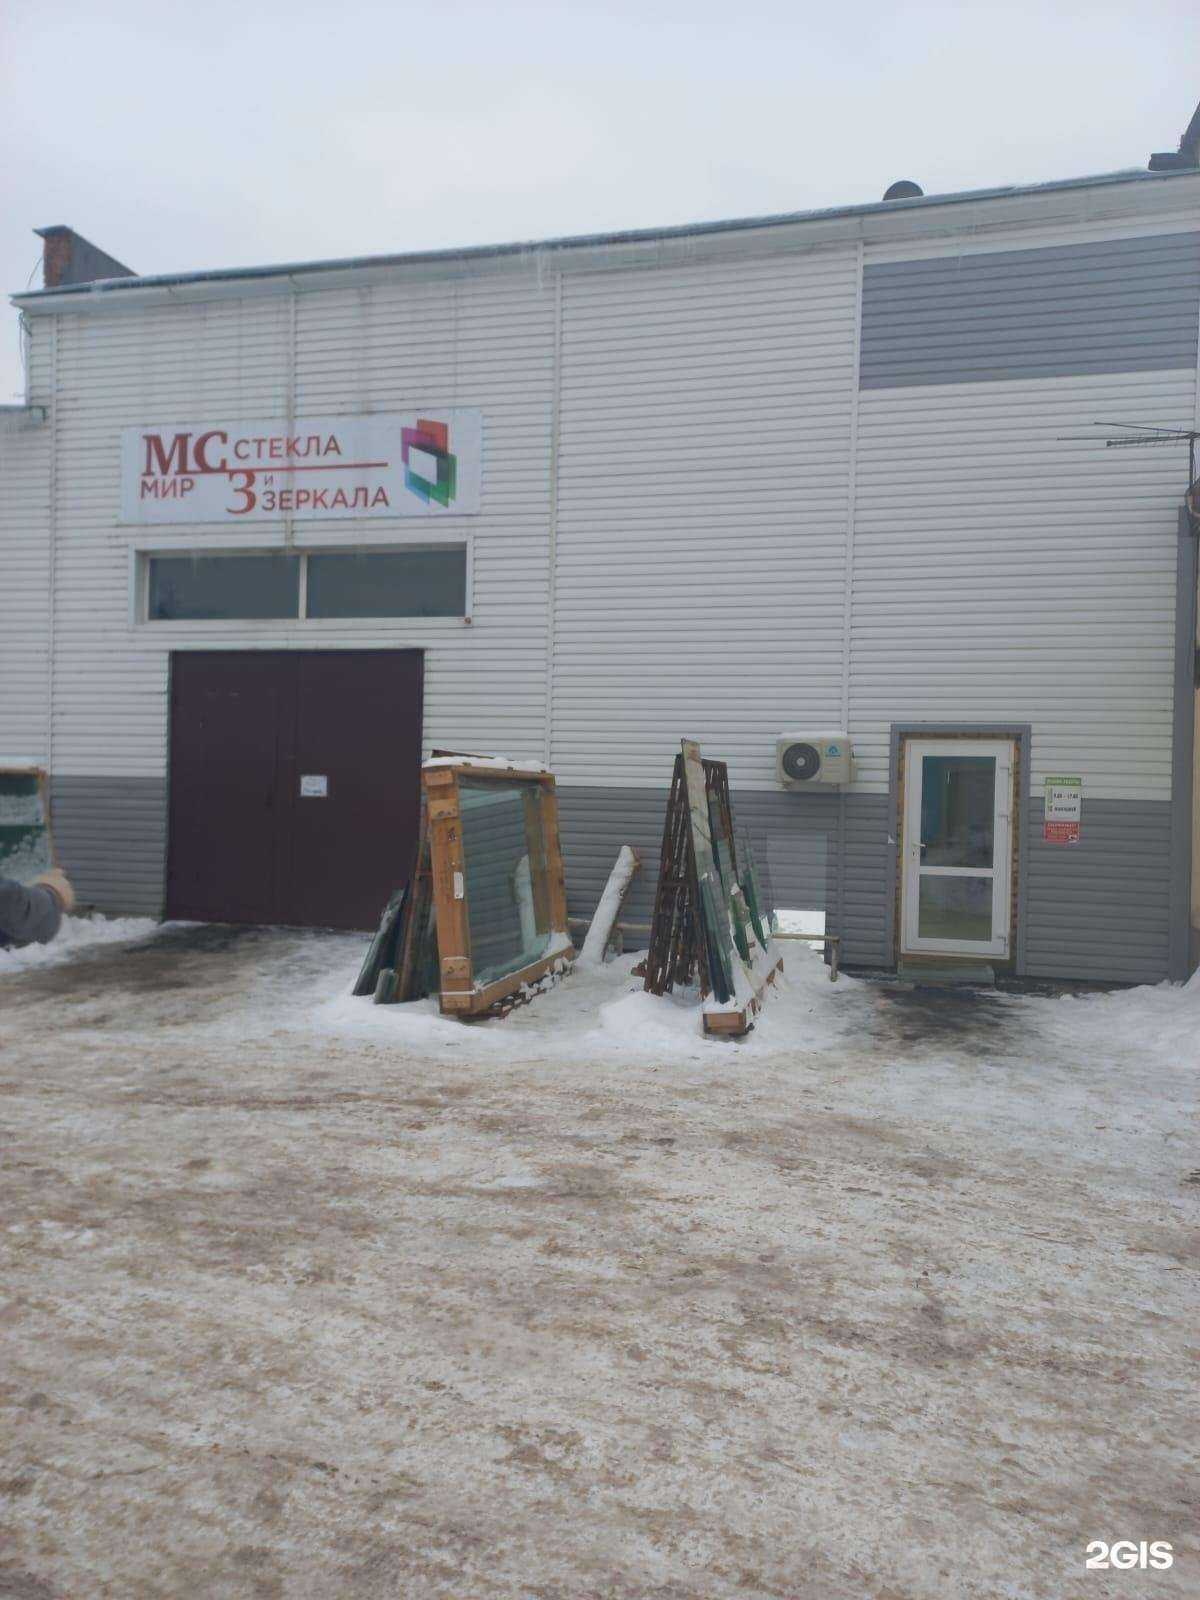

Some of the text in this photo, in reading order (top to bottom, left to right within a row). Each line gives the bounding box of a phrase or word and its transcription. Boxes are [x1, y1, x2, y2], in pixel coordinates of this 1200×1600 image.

[233, 435, 342, 460] СТЕКЛА
[140, 478, 194, 499] МИР
[261, 486, 390, 511] ЗЕРКАЛА
